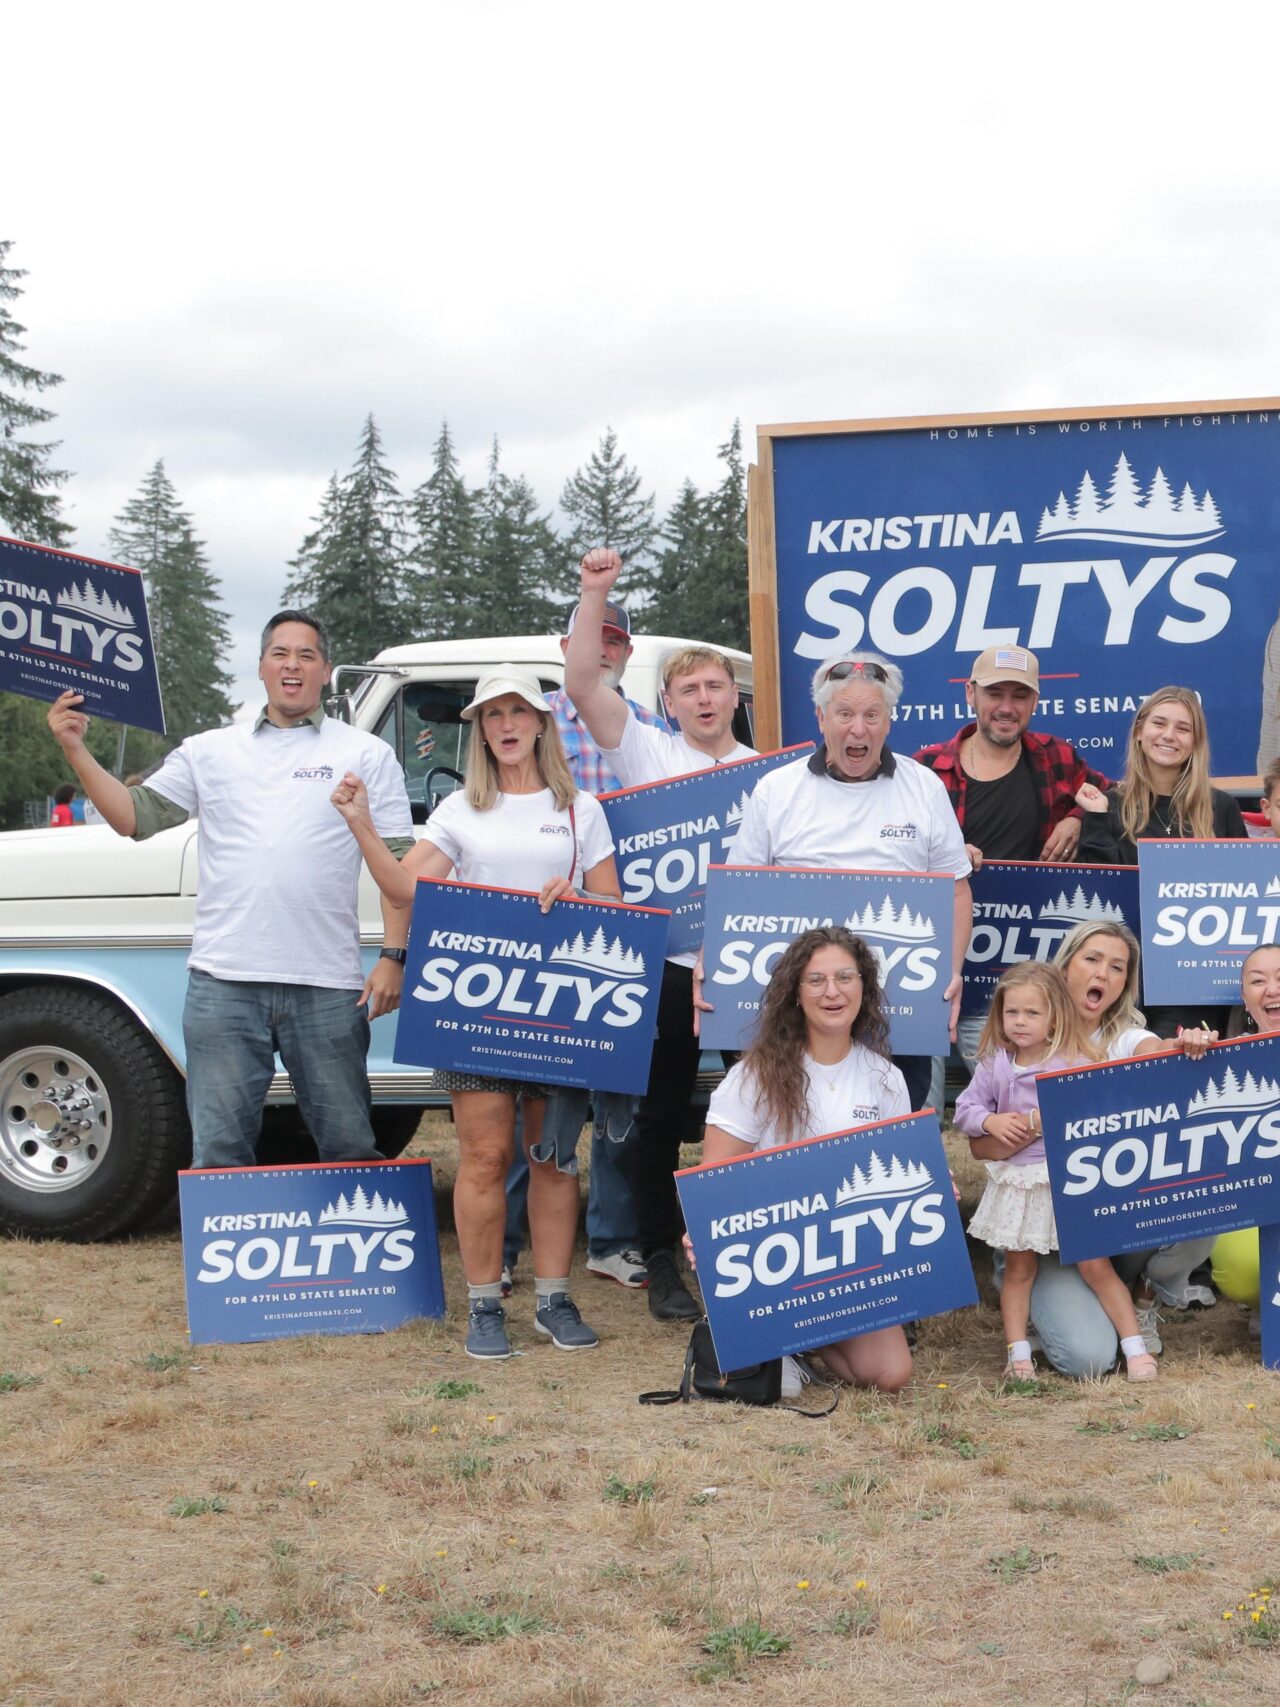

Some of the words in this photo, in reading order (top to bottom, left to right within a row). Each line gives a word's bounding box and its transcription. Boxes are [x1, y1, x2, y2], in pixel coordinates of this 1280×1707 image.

[930, 427, 994, 440] HOME
[1016, 424, 1036, 436] IS
[1058, 419, 1141, 433] WORTH
[807, 511, 1023, 554] KRISTINA
[793, 554, 1238, 660] SOLTYS
[0, 601, 144, 671] OLTYS
[292, 771, 334, 779] SOLTYS
[619, 815, 720, 855] KRISTINA
[880, 828, 916, 838] SOLTYS
[437, 885, 470, 895] HOME
[555, 901, 617, 915] FIGHTING
[627, 911, 649, 919] FOR
[1158, 883, 1259, 898] KRISTINA
[676, 902, 701, 914] 47TH
[428, 930, 542, 961] KRISTINA
[1177, 960, 1197, 968] FOR
[412, 957, 649, 1027] SOLTYS
[738, 1001, 759, 1010] FOR
[899, 1006, 913, 1015] (R)
[436, 1020, 458, 1030] FOR
[463, 1024, 491, 1034] 47TH
[496, 1028, 509, 1036] LD
[514, 1030, 549, 1042] STATE
[553, 1035, 596, 1048] SENATE
[600, 1040, 614, 1051] (R)
[472, 1046, 573, 1064] KRISTINAFORSENATE.COM
[1058, 1072, 1091, 1083] HOME
[1124, 1058, 1167, 1071] WORTH
[1251, 1039, 1273, 1048] FOR
[1065, 1103, 1180, 1141] KRISTINA
[698, 1166, 733, 1179] HOME
[743, 1160, 755, 1168] IS
[765, 1147, 809, 1162] WORTH
[819, 1128, 883, 1149] FIGHTING
[893, 1120, 915, 1130] FOR
[1094, 1206, 1116, 1217] FOR
[1121, 1199, 1150, 1211] 47TH
[1154, 1196, 1168, 1205] LD
[1172, 1188, 1208, 1201] STATE
[1212, 1178, 1255, 1194] SENATE
[1258, 1174, 1272, 1186] (R)
[203, 1211, 312, 1233] KRISTINA
[711, 1193, 829, 1239] KRISTINA
[1136, 1203, 1237, 1229] KRISTINAFORSENATE.COM
[197, 1230, 415, 1283] SOLTYS
[715, 1193, 945, 1298] SOLTYS
[225, 1296, 247, 1304] FOR
[251, 1294, 279, 1303] 47TH
[283, 1293, 296, 1301] LD
[300, 1290, 334, 1300] STATE
[338, 1287, 379, 1297] SENATE
[382, 1285, 396, 1295] (R)
[749, 1306, 773, 1319] FOR
[778, 1296, 807, 1310] 47TH
[811, 1292, 825, 1302] LD
[829, 1280, 866, 1297] STATE
[870, 1267, 914, 1286] SENATE
[917, 1262, 931, 1274] (R)
[264, 1308, 362, 1320] KRISTINAFORSENATE.COM
[794, 1295, 898, 1328] KRISTINAFORSENATE.COM
